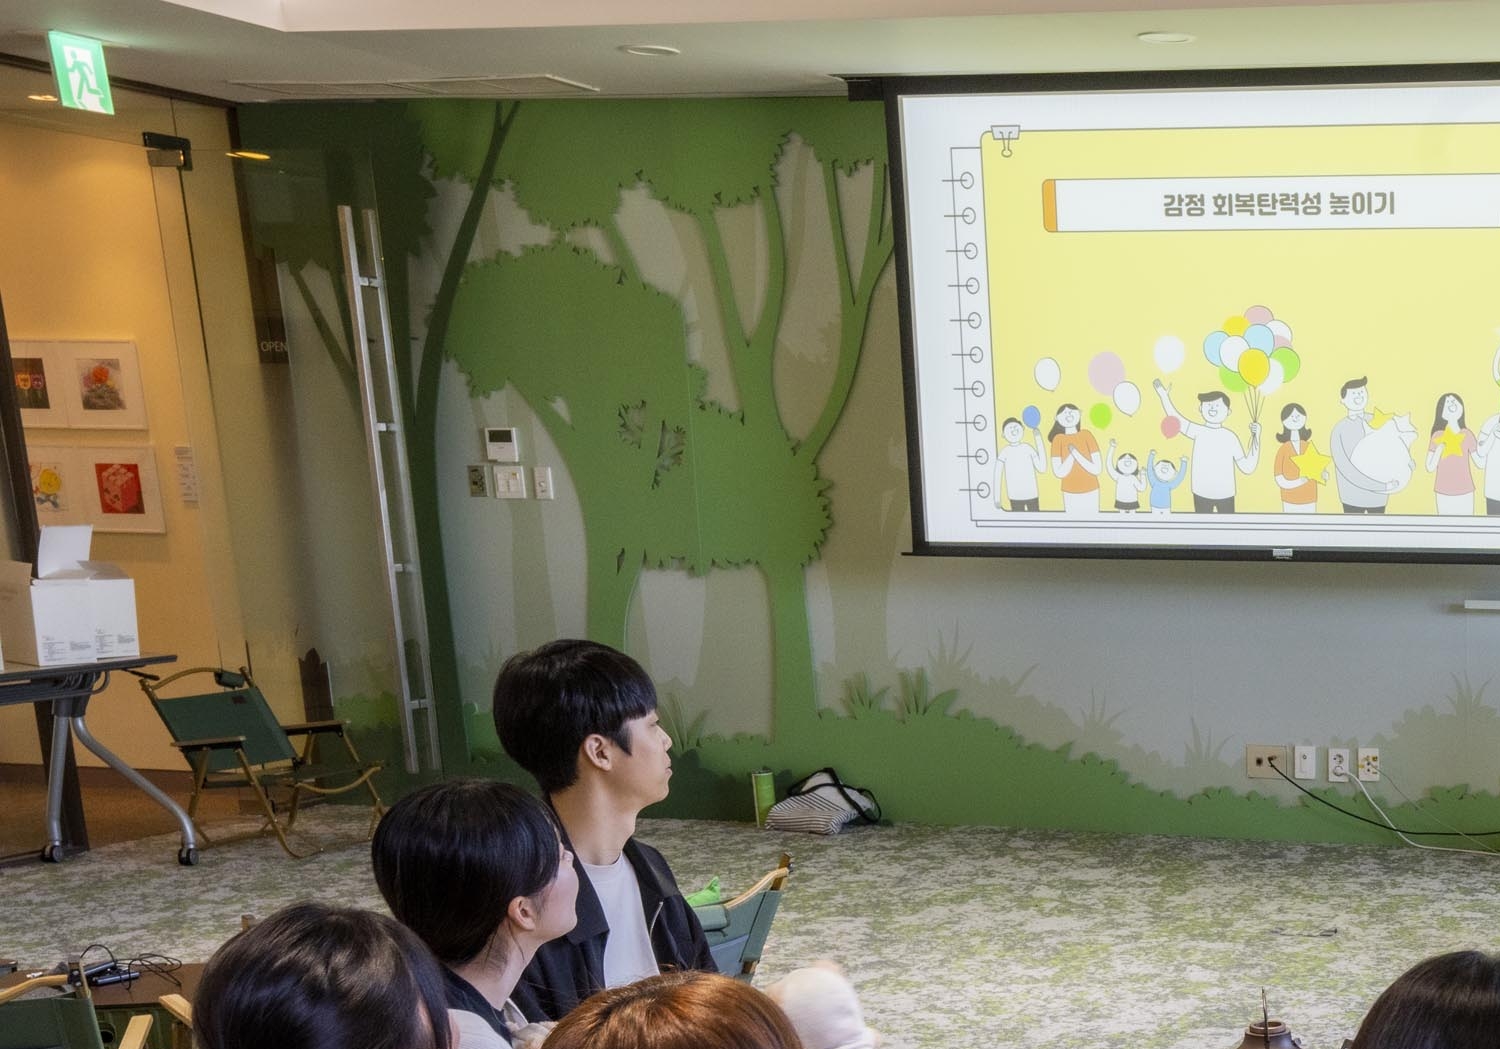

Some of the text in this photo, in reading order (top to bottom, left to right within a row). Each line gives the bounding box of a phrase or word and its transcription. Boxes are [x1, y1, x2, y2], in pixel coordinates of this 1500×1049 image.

[1163, 191, 1396, 217] 감정 회복탄력성 높이기
[260, 341, 288, 352] OPEN
